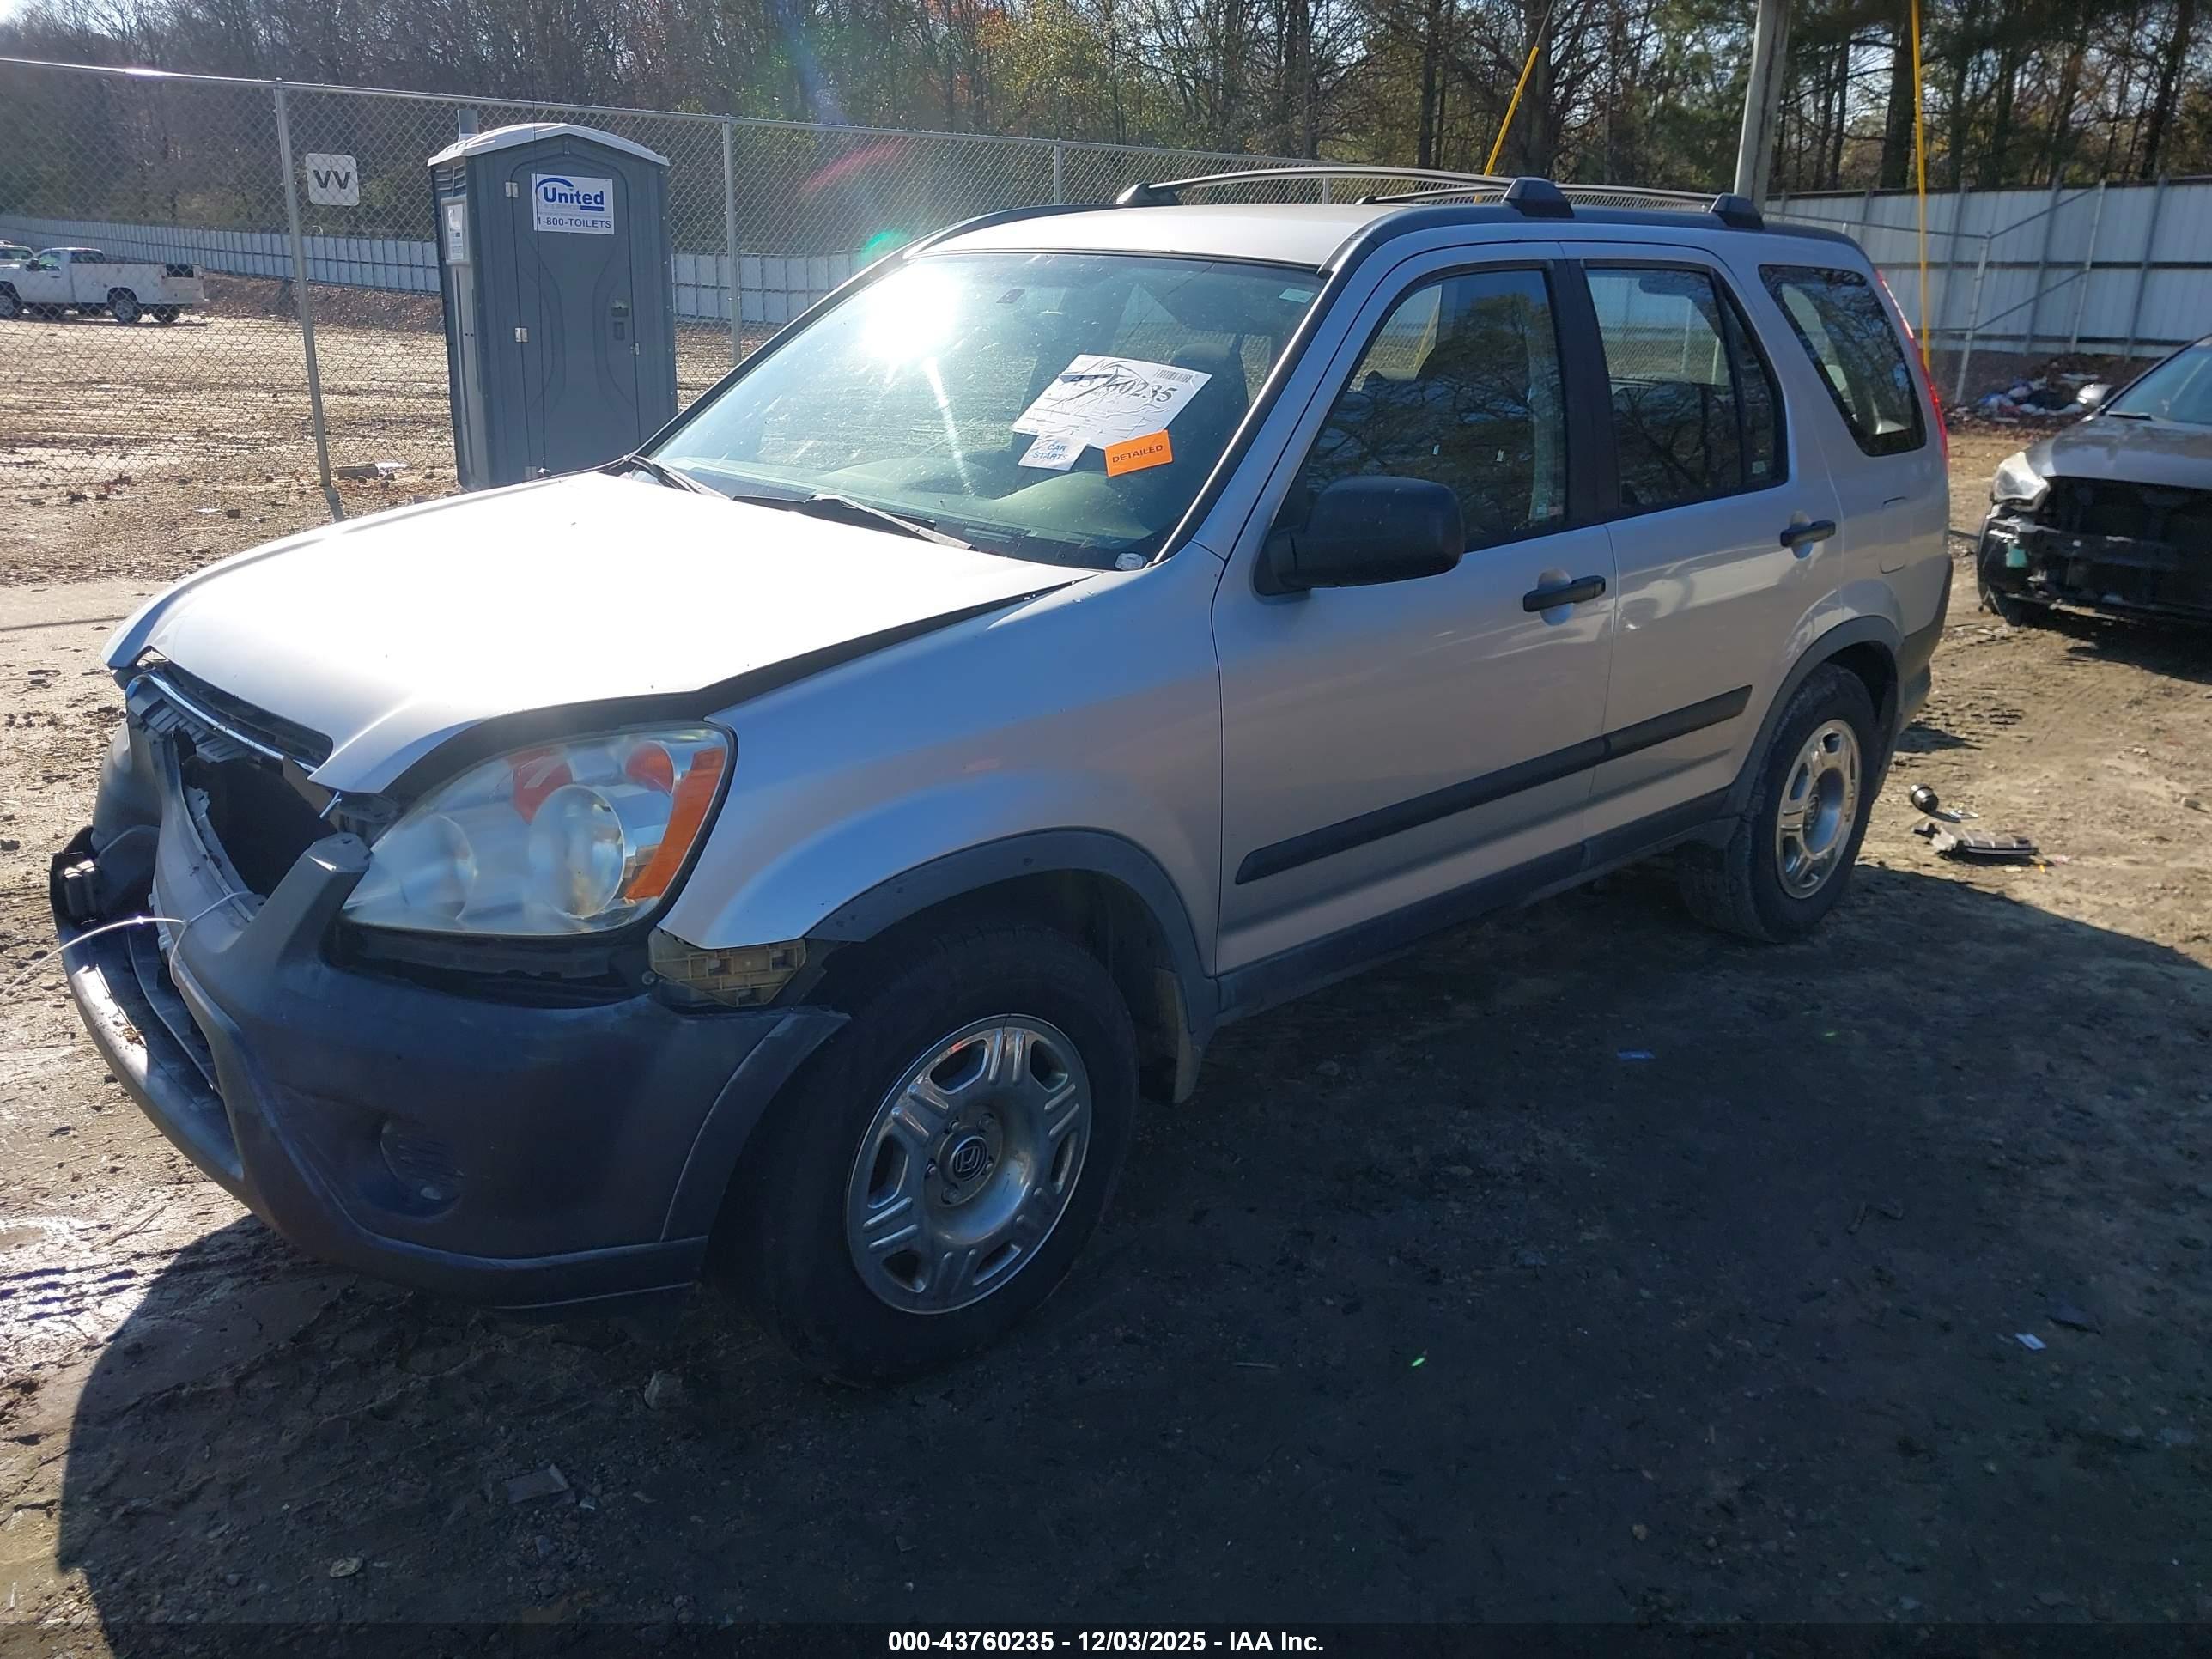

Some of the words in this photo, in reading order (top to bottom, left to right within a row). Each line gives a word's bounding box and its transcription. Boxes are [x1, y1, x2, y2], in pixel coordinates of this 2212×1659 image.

[543, 186, 605, 206] United
[538, 216, 611, 229] 1-800-TOILETS
[1047, 444, 1067, 453] CAR
[1112, 444, 1164, 463] DETAILED
[1033, 452, 1068, 460] STARTS
